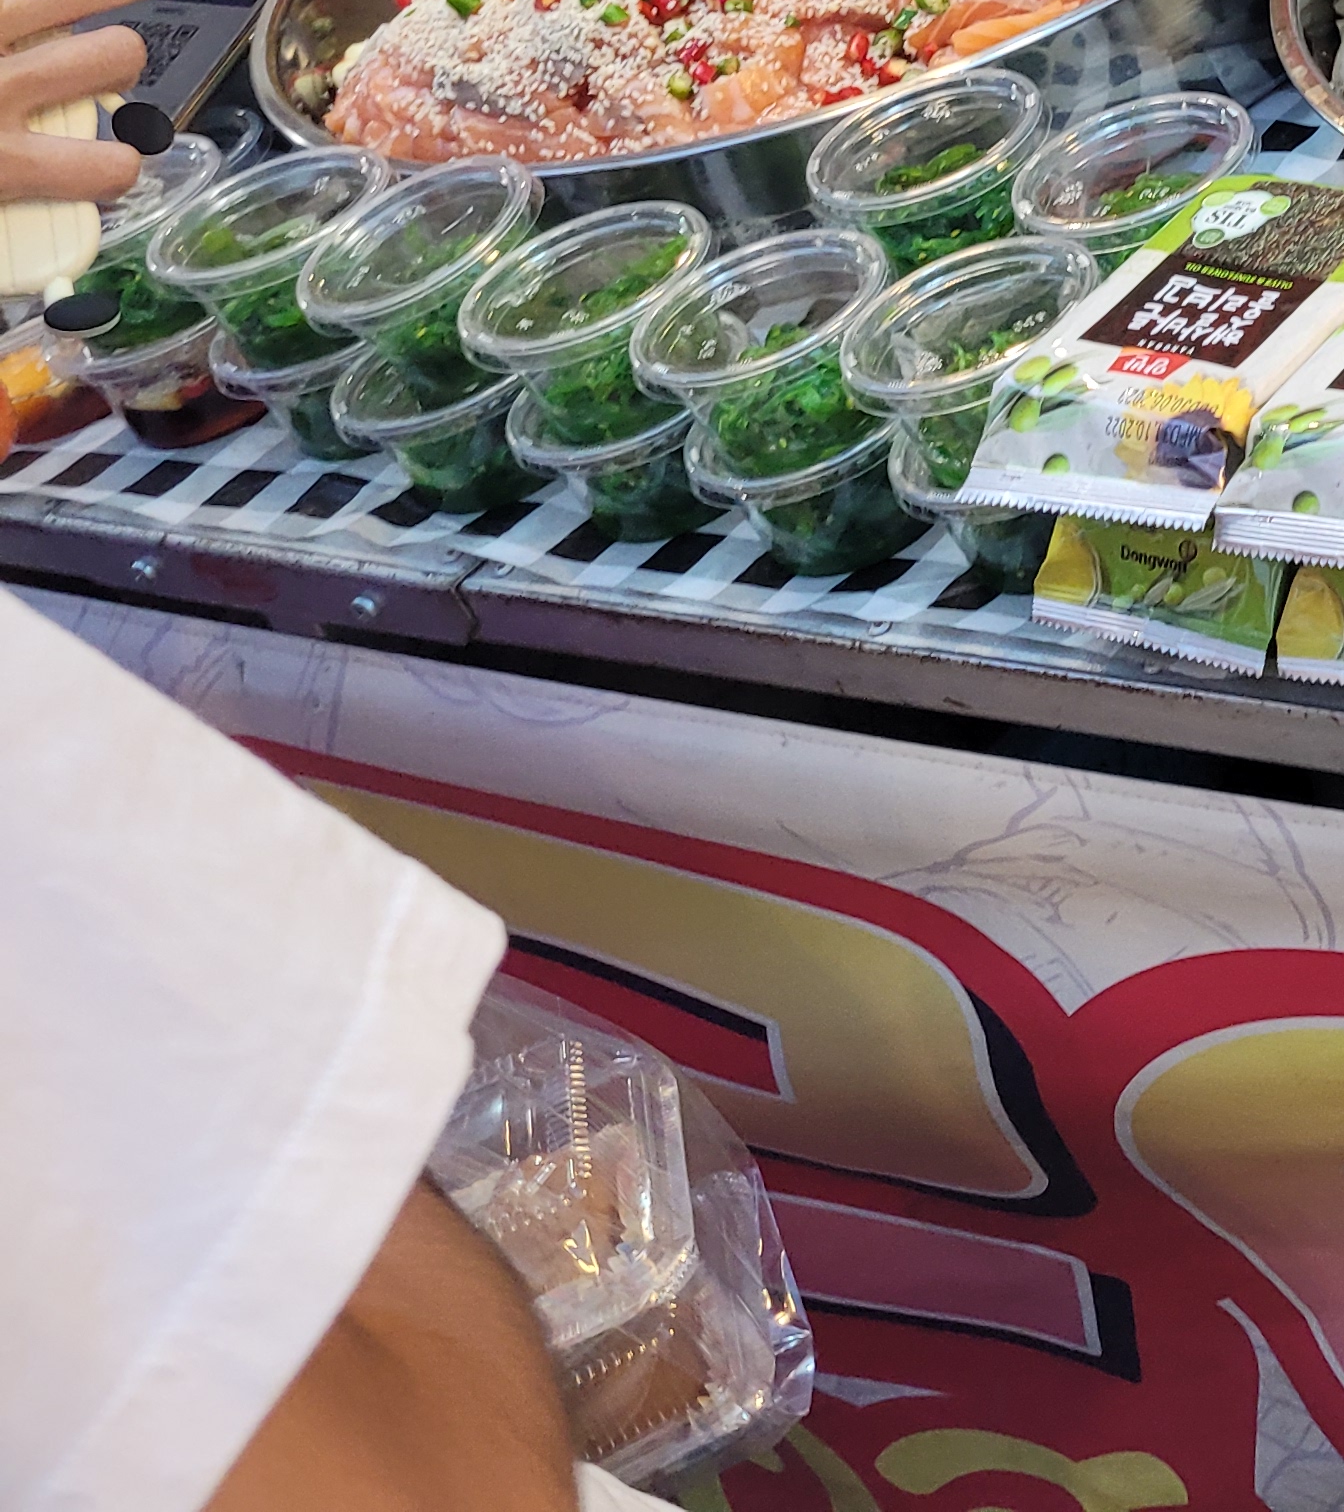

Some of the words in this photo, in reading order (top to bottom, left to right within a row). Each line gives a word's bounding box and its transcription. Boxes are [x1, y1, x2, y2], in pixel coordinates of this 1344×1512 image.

[1204, 209, 1246, 229] TIS
[1153, 274, 1282, 320] 올리브김
[1127, 302, 1255, 348] 햇살바른
[1121, 354, 1171, 376] 양반
[1120, 543, 1188, 574] Dongwon
